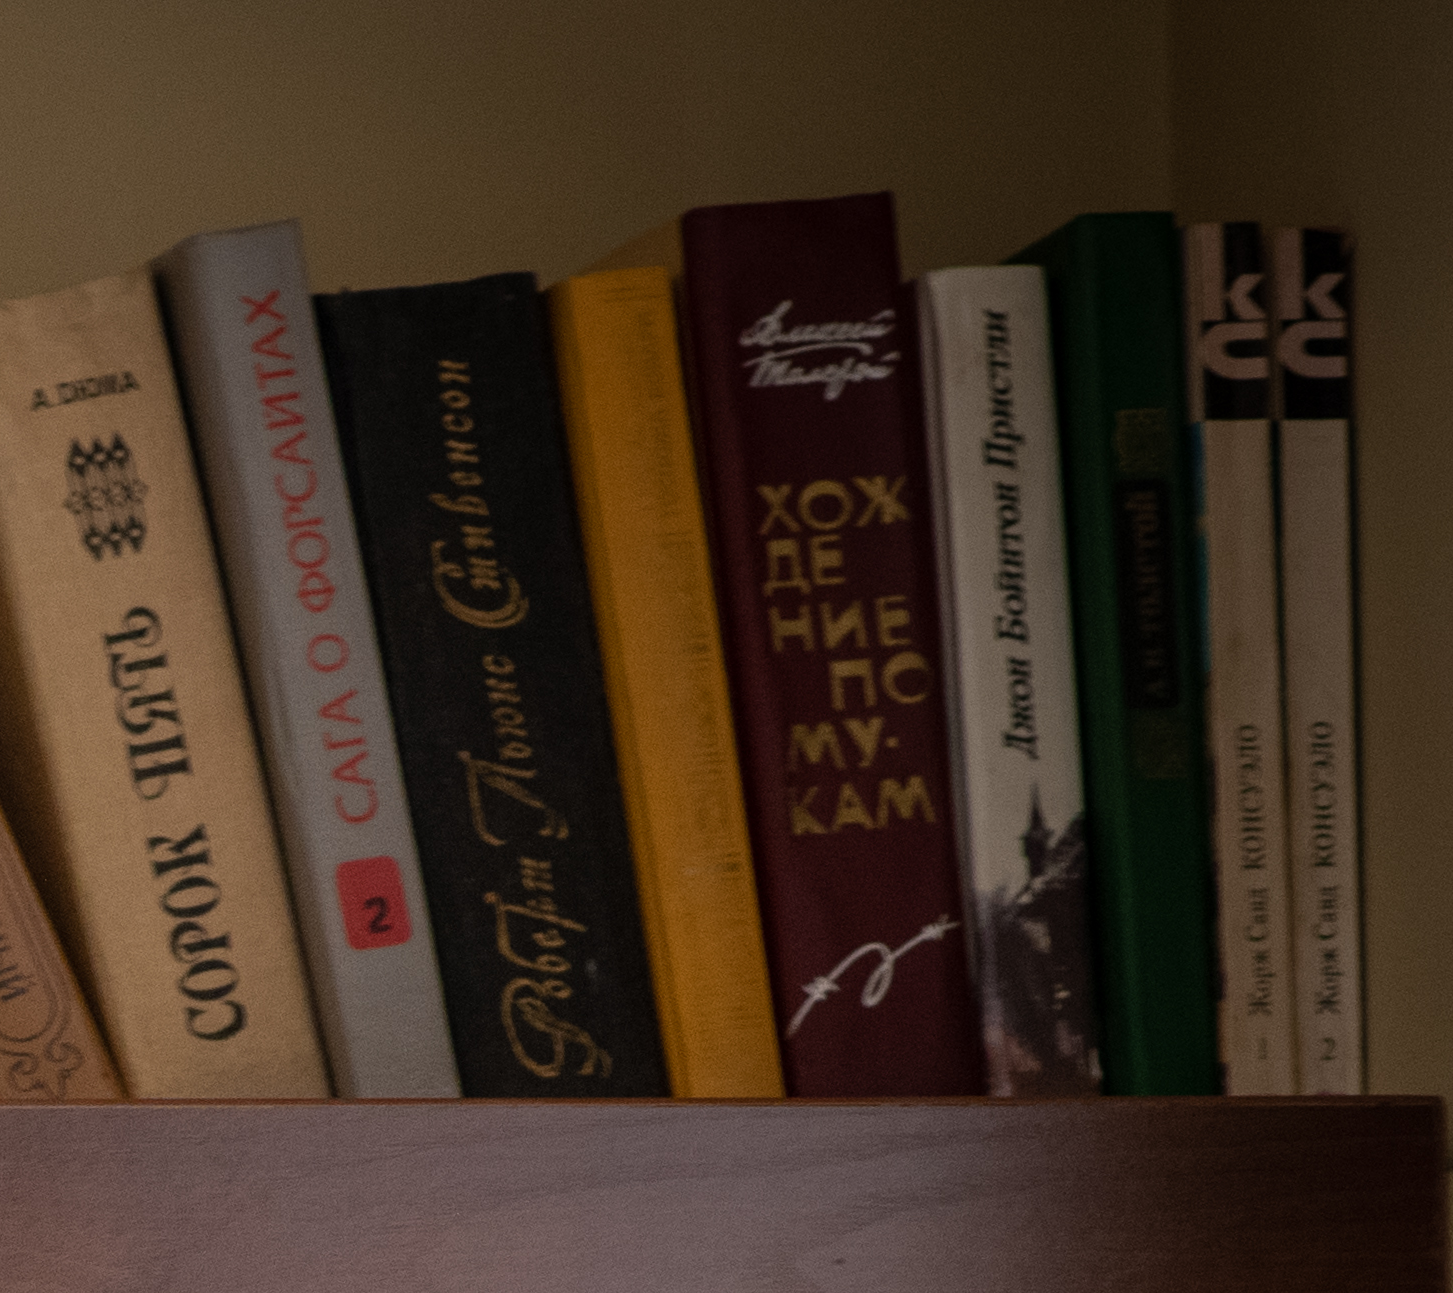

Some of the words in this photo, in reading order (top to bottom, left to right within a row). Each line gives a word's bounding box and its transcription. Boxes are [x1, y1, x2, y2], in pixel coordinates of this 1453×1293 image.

[973, 308, 1025, 473] Пристли
[762, 539, 844, 595] ДЕ
[983, 481, 1028, 646] Бойнтон
[304, 629, 352, 675] О
[770, 596, 913, 652] НИЕ
[97, 601, 197, 803] ПЯТЬ
[831, 653, 932, 707] ПО
[999, 656, 1038, 761] Джон
[315, 688, 381, 826] САГА
[788, 775, 938, 836] КАМ
[1231, 722, 1267, 871] КОНСУЭЛО
[1307, 720, 1335, 868] КОНСУЭЛО
[146, 823, 250, 1046] СОРОК
[361, 895, 394, 935] 2
[1243, 886, 1270, 942] Санд
[1315, 885, 1338, 942] Санд
[1244, 948, 1276, 1015] Жорж
[1314, 948, 1341, 1015] Жорж
